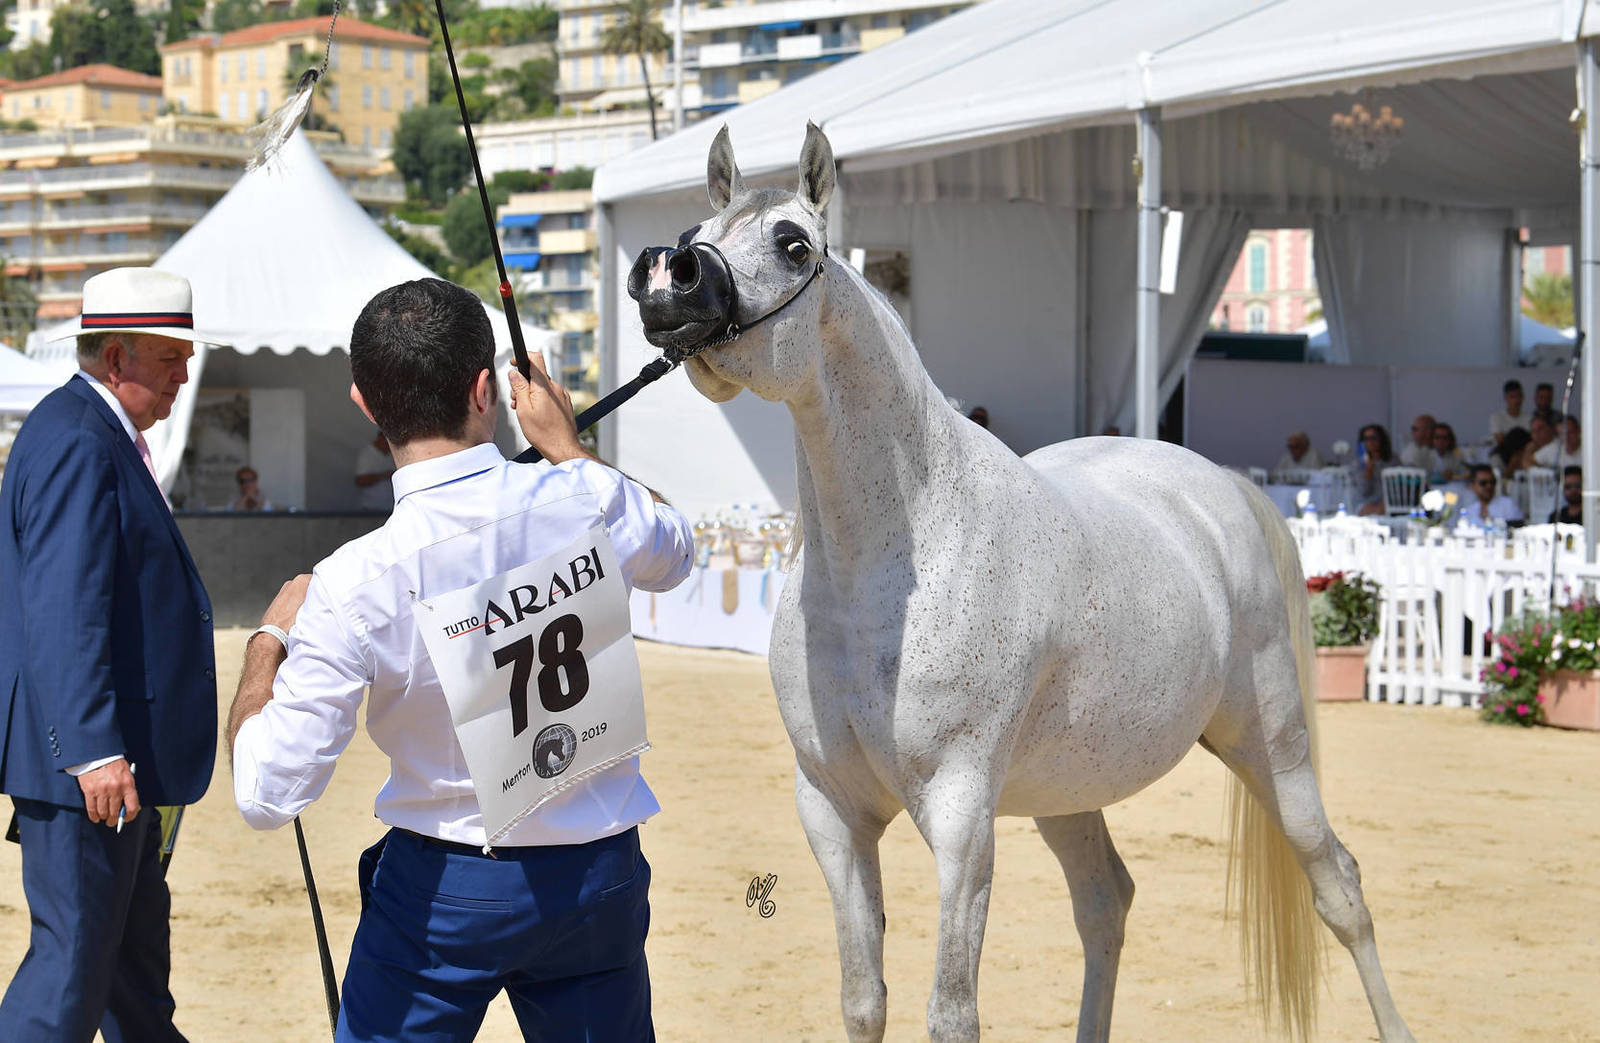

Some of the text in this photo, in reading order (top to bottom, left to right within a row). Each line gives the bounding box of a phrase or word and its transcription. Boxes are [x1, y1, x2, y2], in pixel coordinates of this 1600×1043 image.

[443, 546, 605, 637] TUTTO ARABI
[492, 613, 590, 739] 78
[502, 763, 531, 794] Menton
[581, 722, 608, 743] 2019
